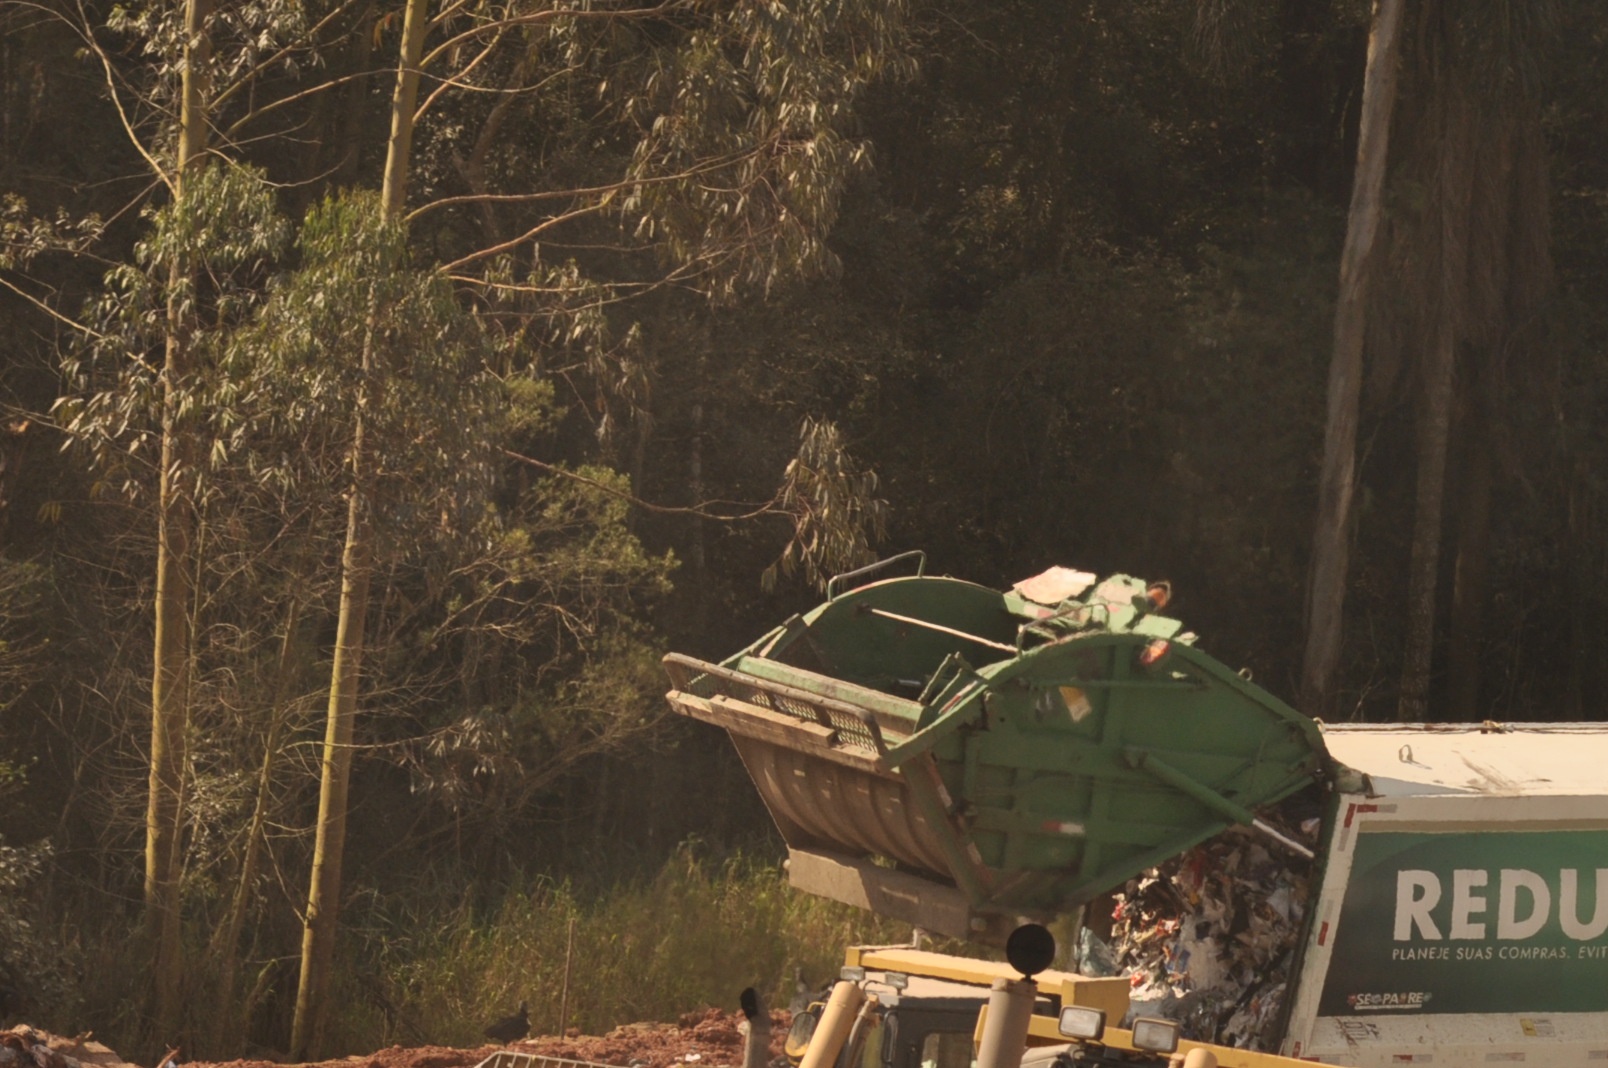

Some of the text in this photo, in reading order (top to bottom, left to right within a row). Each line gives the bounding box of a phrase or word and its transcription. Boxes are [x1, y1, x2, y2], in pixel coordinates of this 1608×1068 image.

[1391, 947, 1450, 961] PLANEJE
[1456, 946, 1493, 960] SUAS
[1498, 946, 1571, 960] COMPRAS.
